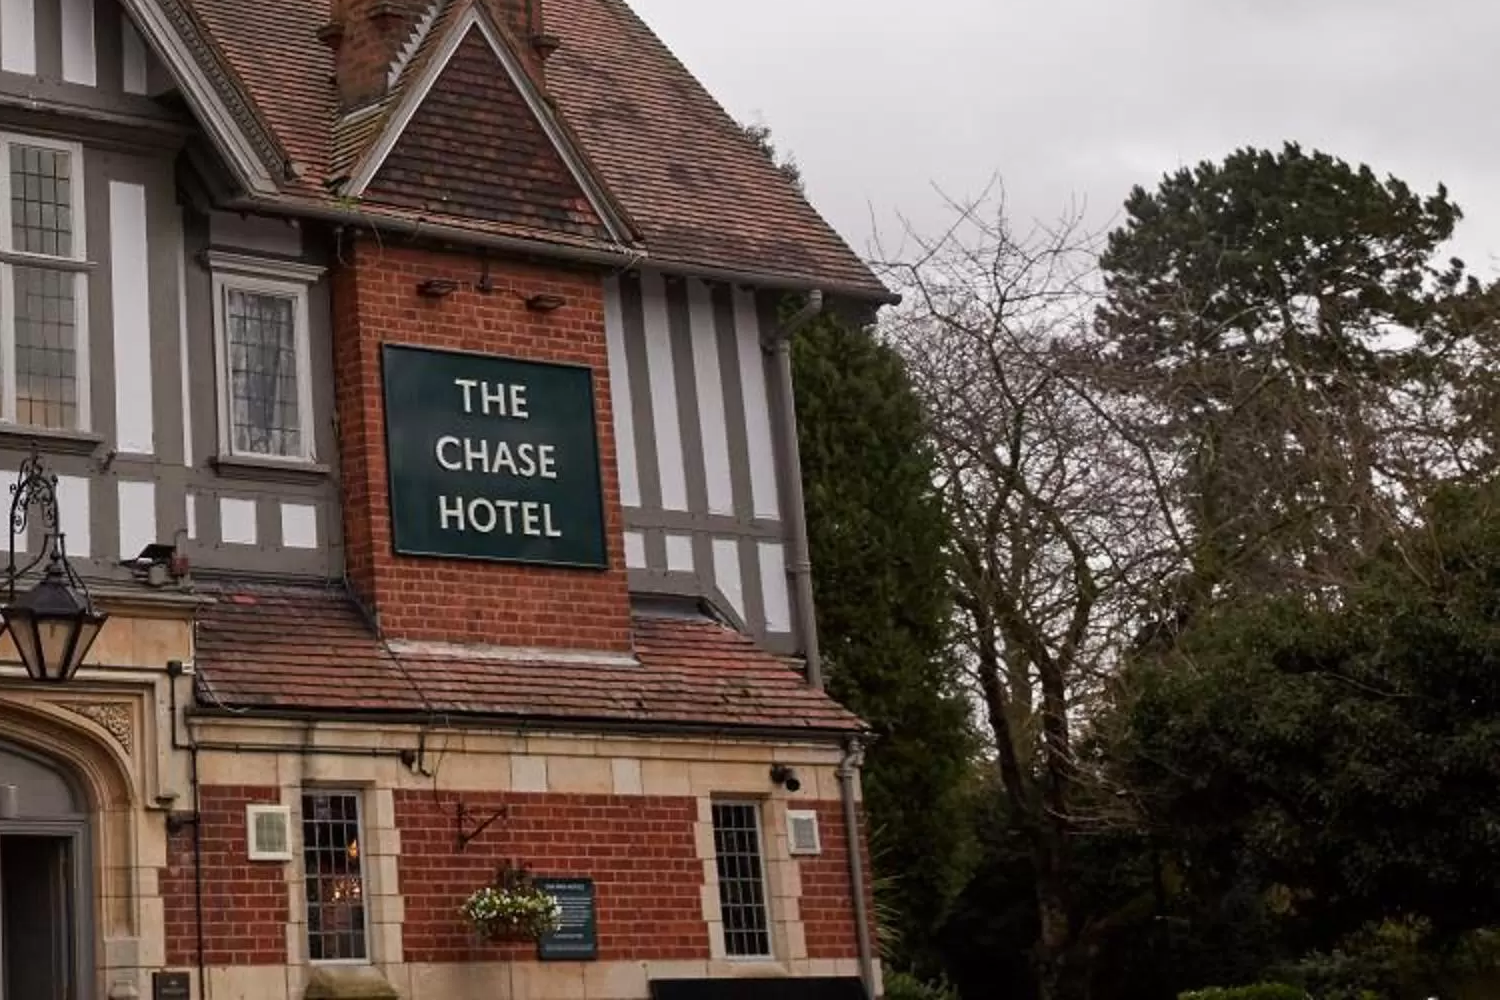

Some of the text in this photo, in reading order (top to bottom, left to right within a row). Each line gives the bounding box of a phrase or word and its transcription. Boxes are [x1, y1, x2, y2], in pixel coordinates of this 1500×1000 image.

[454, 378, 529, 419] THE
[435, 435, 557, 479] CHASE
[438, 495, 562, 537] HOTEL
